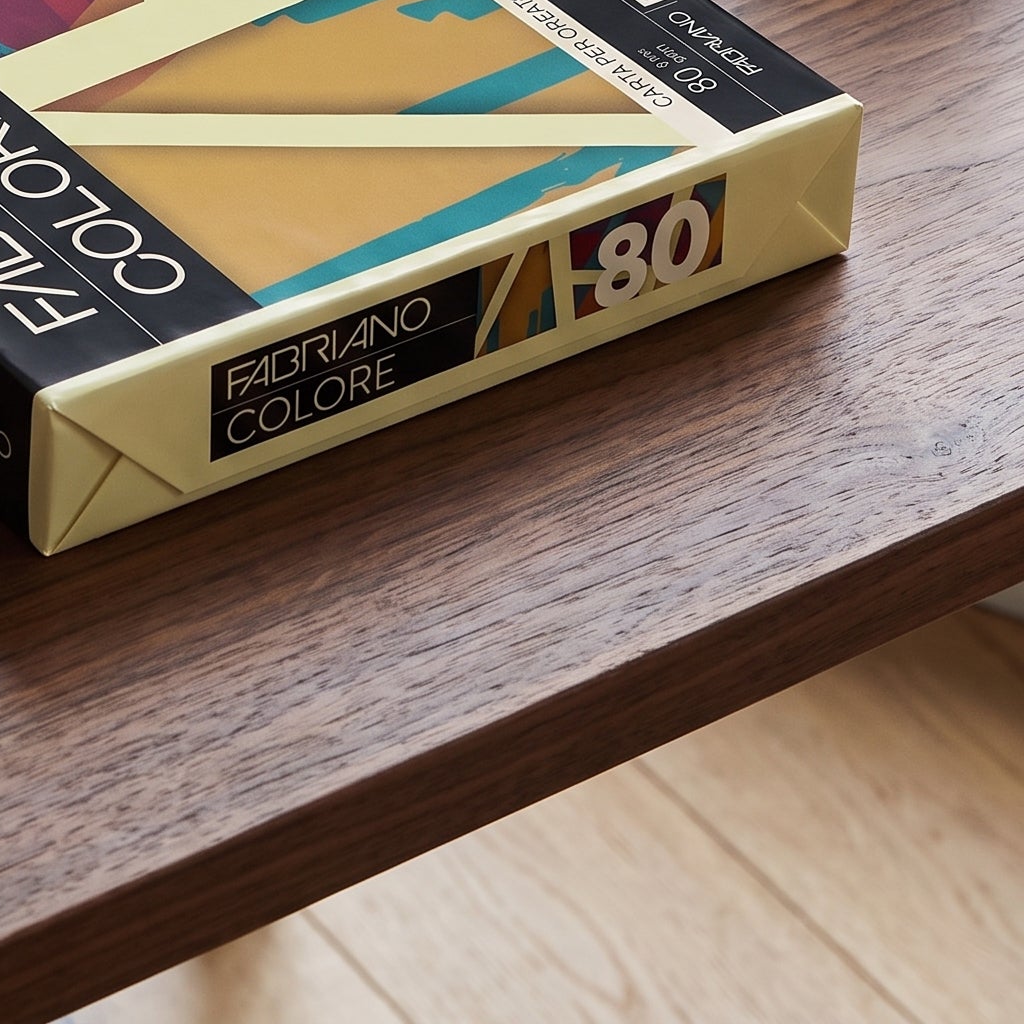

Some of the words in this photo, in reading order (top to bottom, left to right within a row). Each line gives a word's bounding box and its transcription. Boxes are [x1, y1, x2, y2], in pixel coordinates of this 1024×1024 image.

[574, 38, 616, 66] PER
[668, 10, 764, 77] FABRIANO
[612, 64, 673, 108] CARTA
[673, 66, 718, 94] 80
[593, 199, 711, 309] 80
[226, 296, 433, 401] FABRIANO
[226, 352, 397, 445] COLORE
